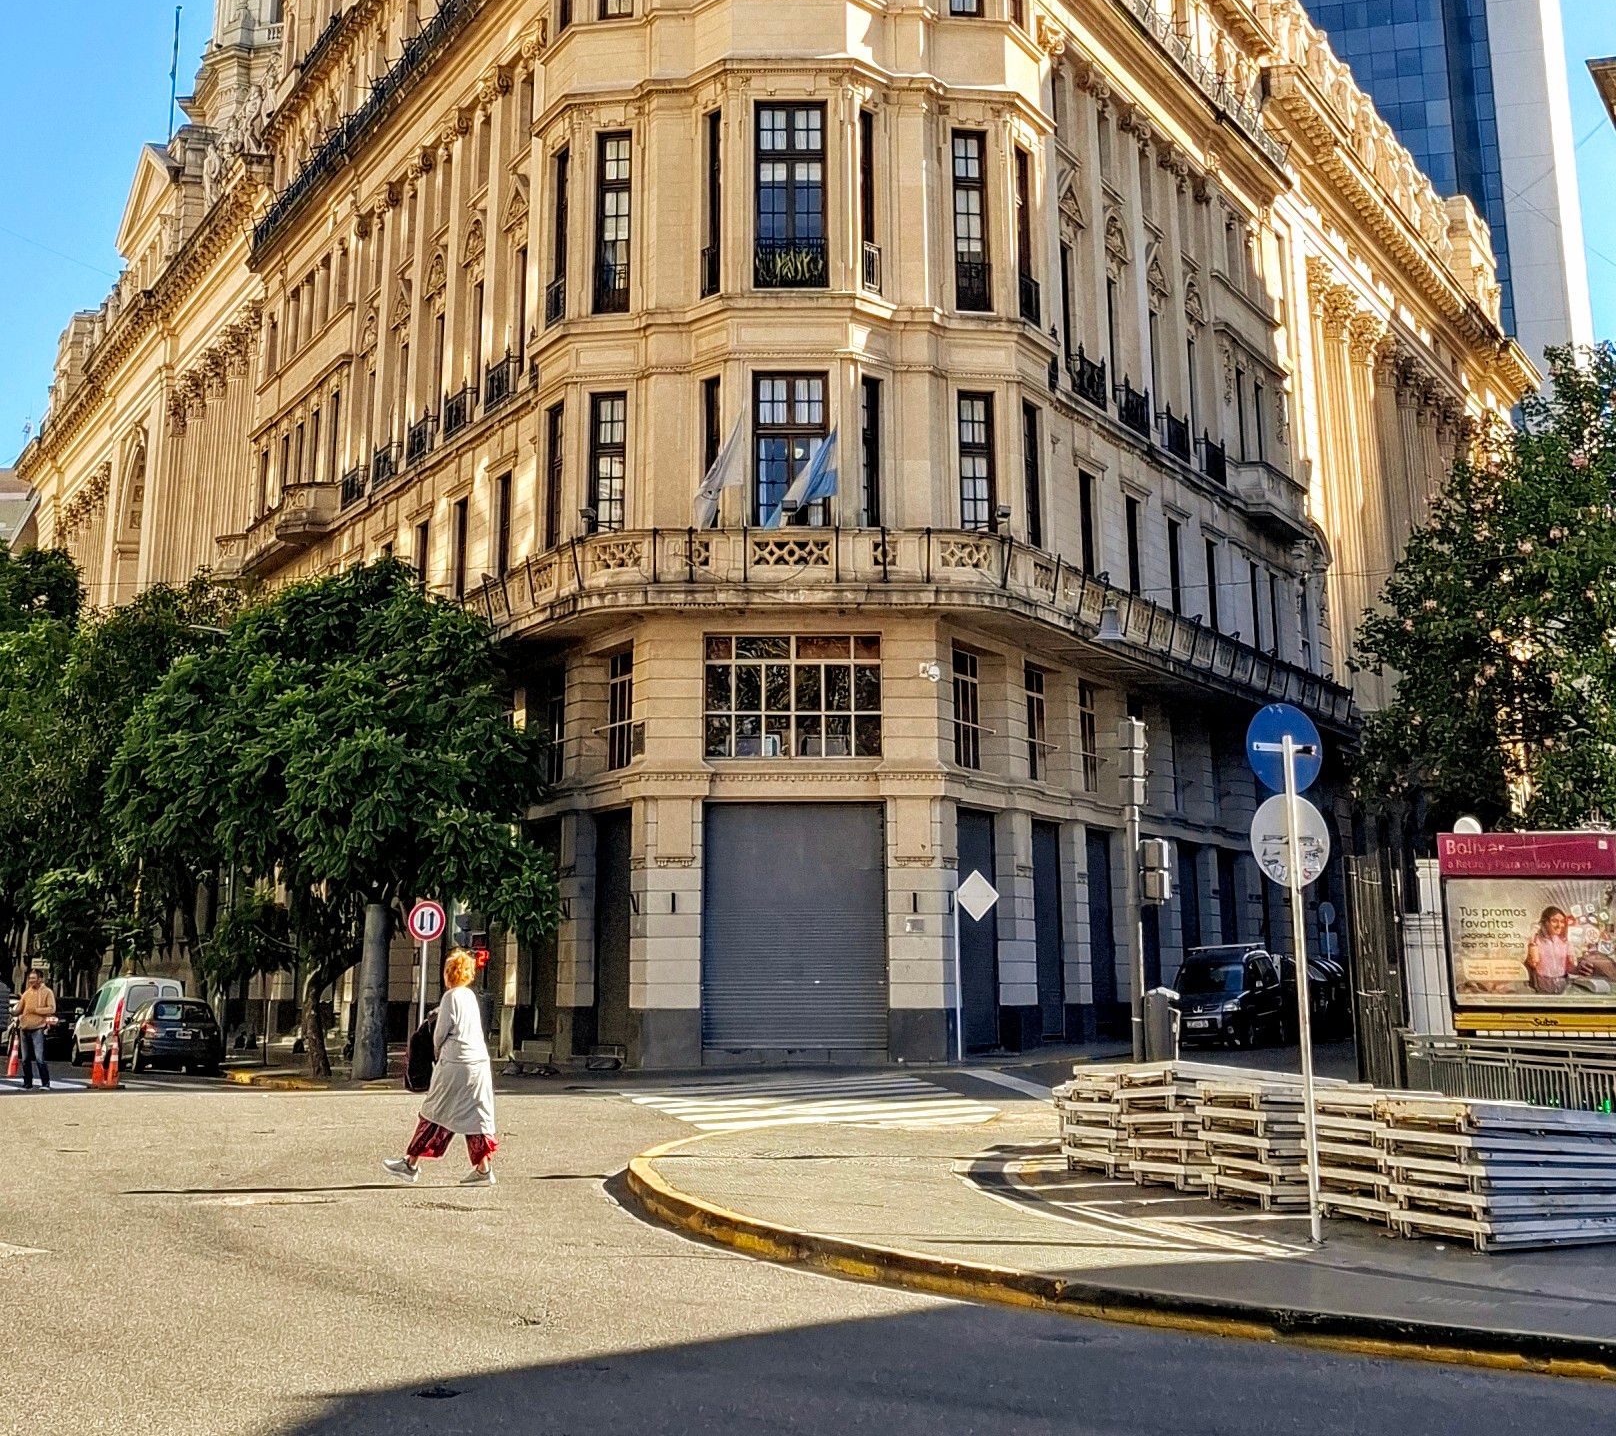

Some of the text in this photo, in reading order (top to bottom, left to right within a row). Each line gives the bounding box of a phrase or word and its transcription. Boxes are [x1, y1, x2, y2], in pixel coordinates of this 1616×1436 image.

[1459, 906, 1527, 919] Tus promos
[1460, 918, 1514, 929] favoritas
